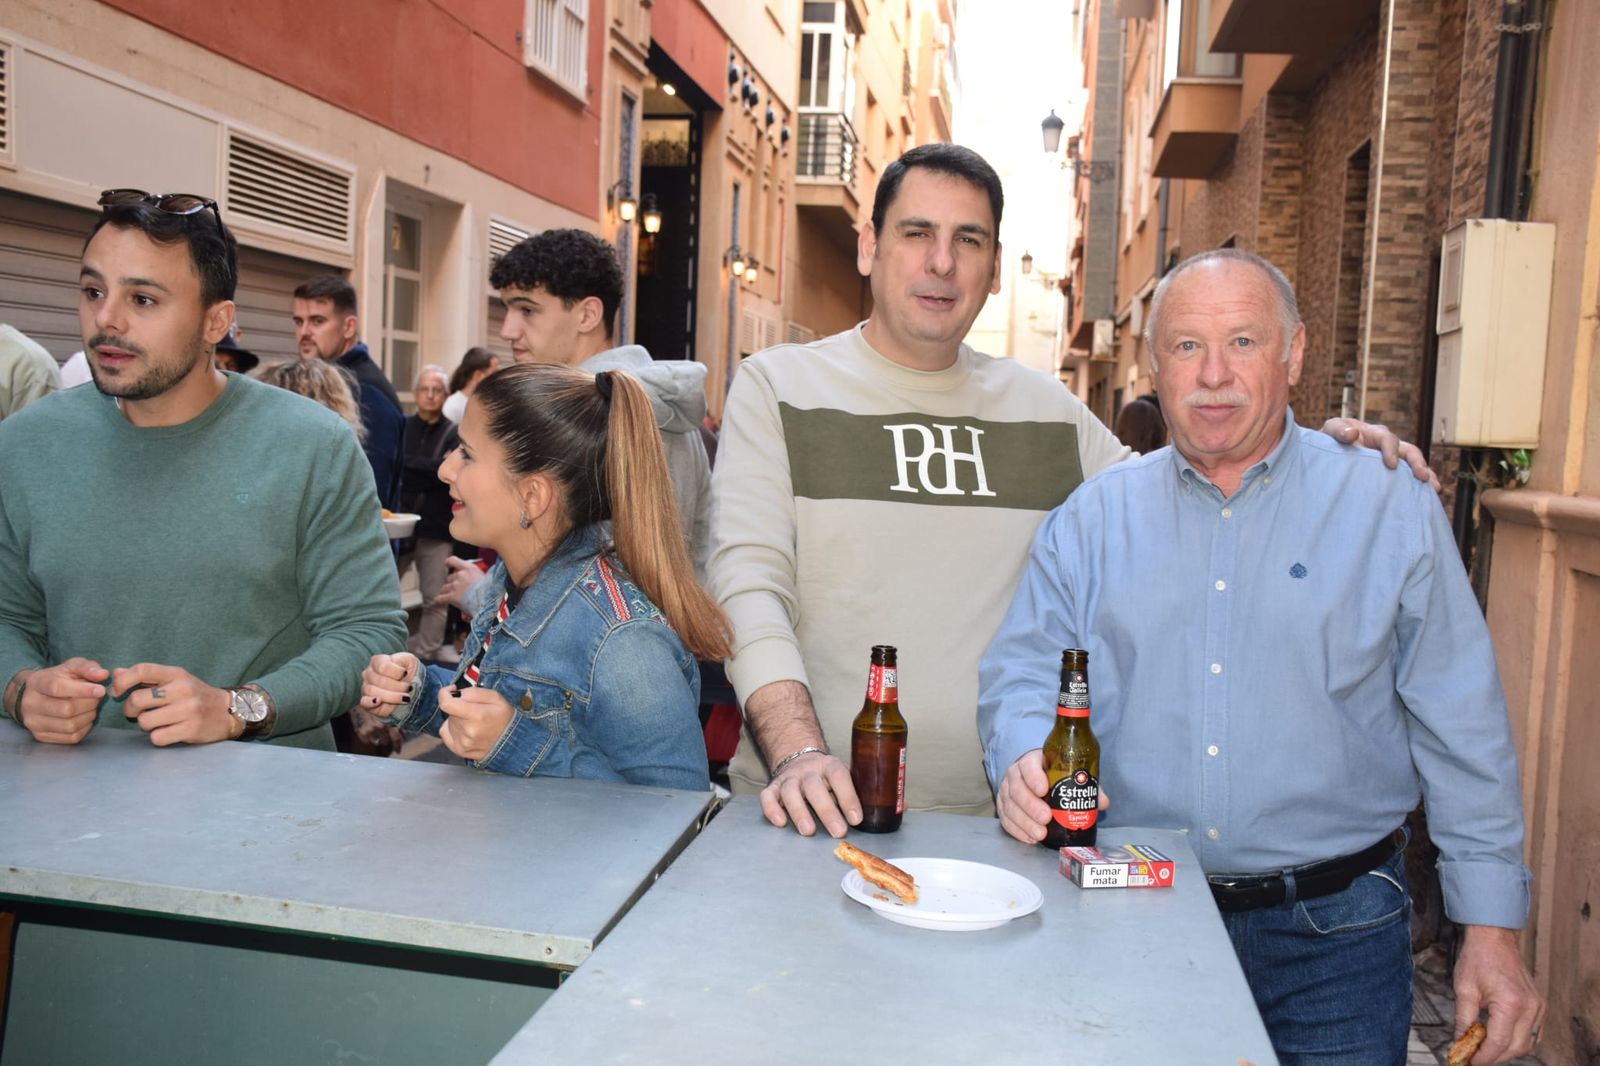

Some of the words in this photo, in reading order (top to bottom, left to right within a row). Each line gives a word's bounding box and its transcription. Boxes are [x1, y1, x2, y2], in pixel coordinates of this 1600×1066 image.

[1059, 785, 1097, 797] Estrella
[1060, 797, 1096, 809] Galicia
[1090, 867, 1121, 876] Fumar
[1093, 877, 1118, 885] mata
